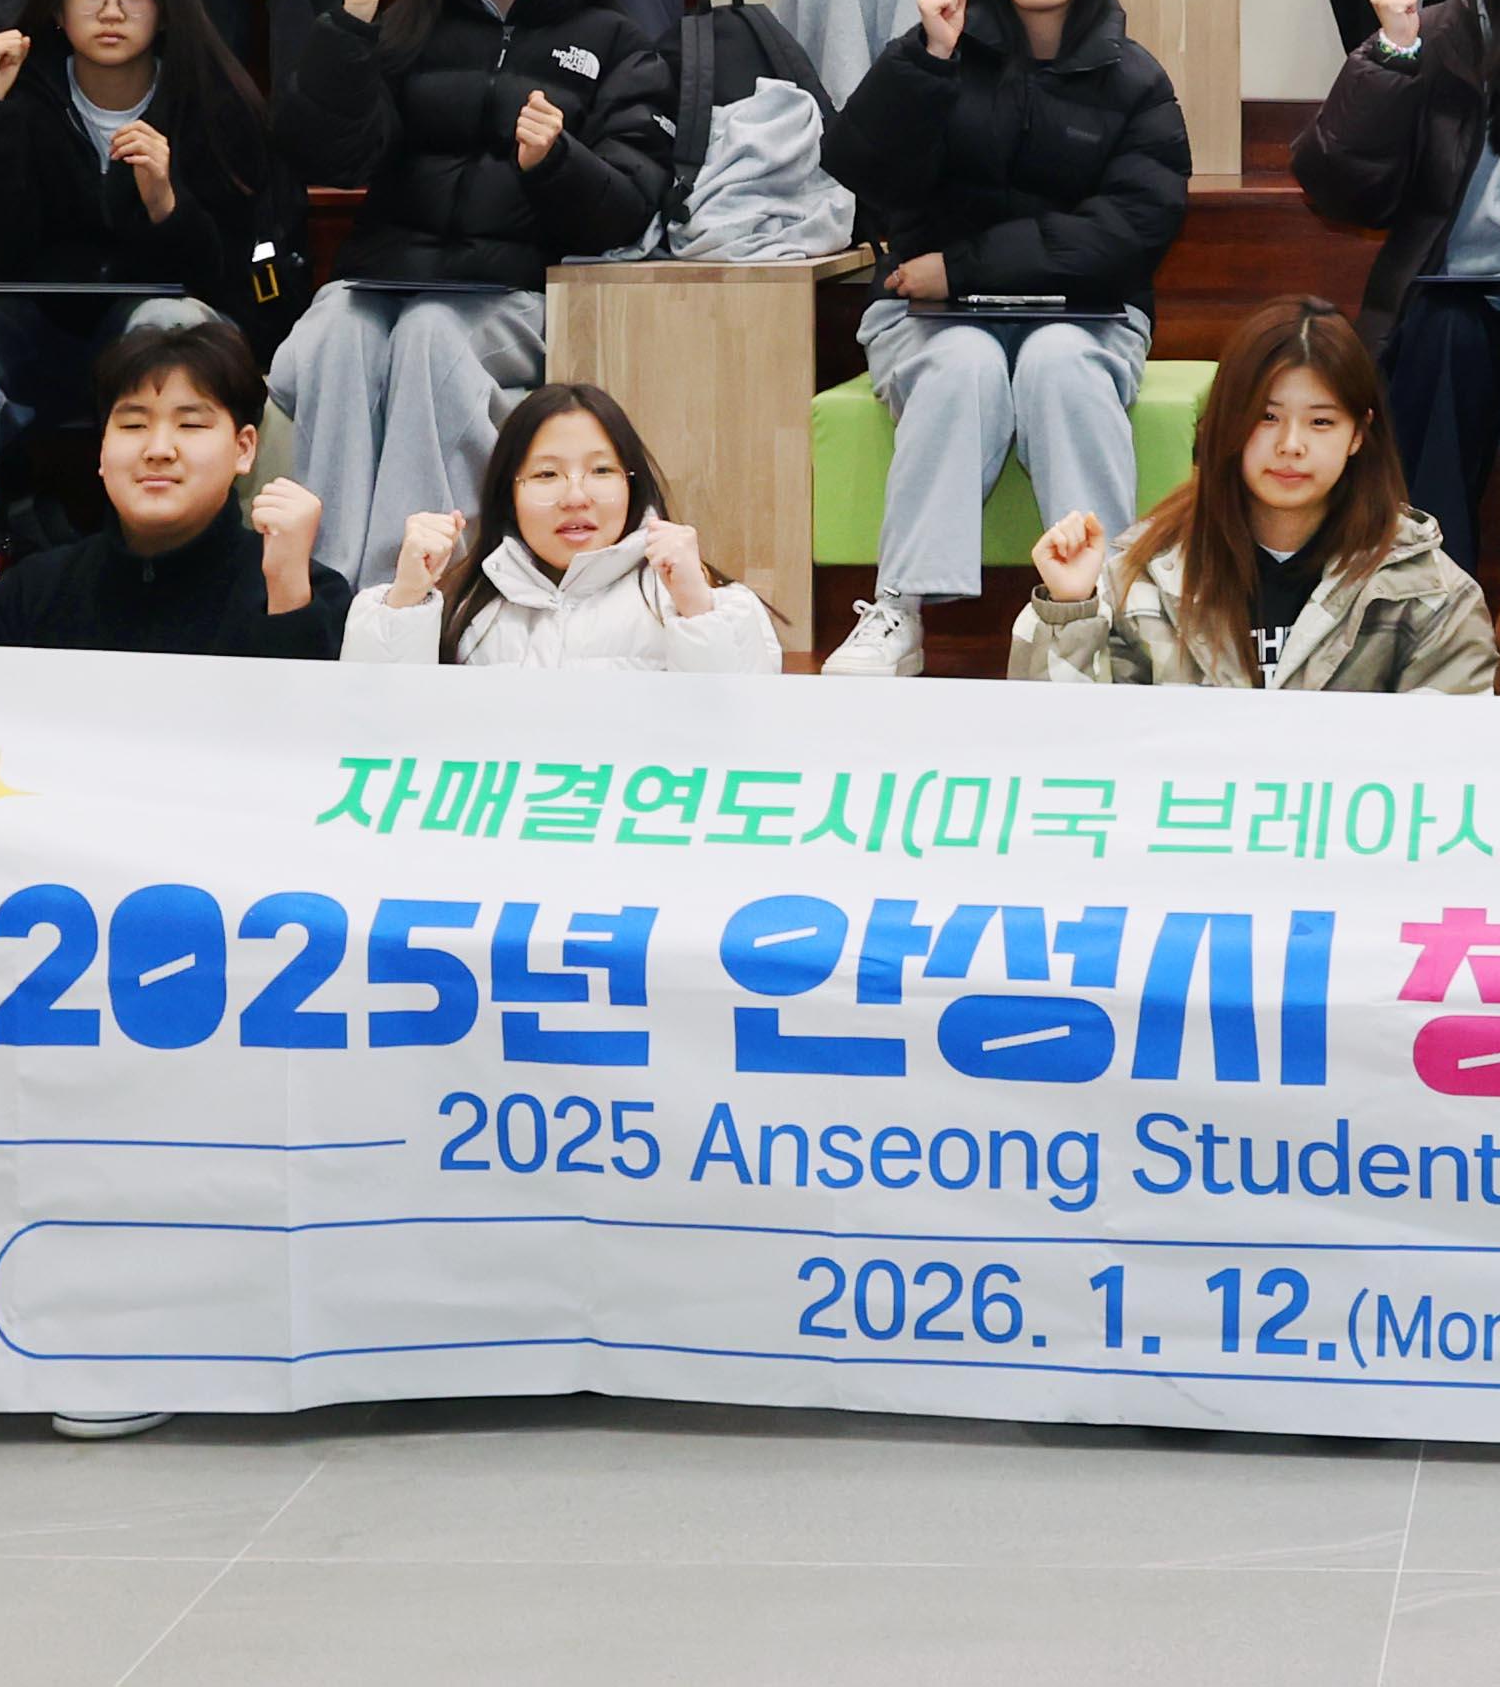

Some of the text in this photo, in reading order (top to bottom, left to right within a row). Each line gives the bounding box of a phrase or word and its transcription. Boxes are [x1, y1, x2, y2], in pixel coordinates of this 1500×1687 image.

[318, 758, 1117, 861] 자매결연도시(미국
[718, 896, 1336, 1087] 안성시
[438, 1092, 663, 1182] 2025
[689, 1102, 1101, 1214] Anseong
[797, 1256, 1050, 1350] 2026.
[1090, 1265, 1162, 1356] 1.
